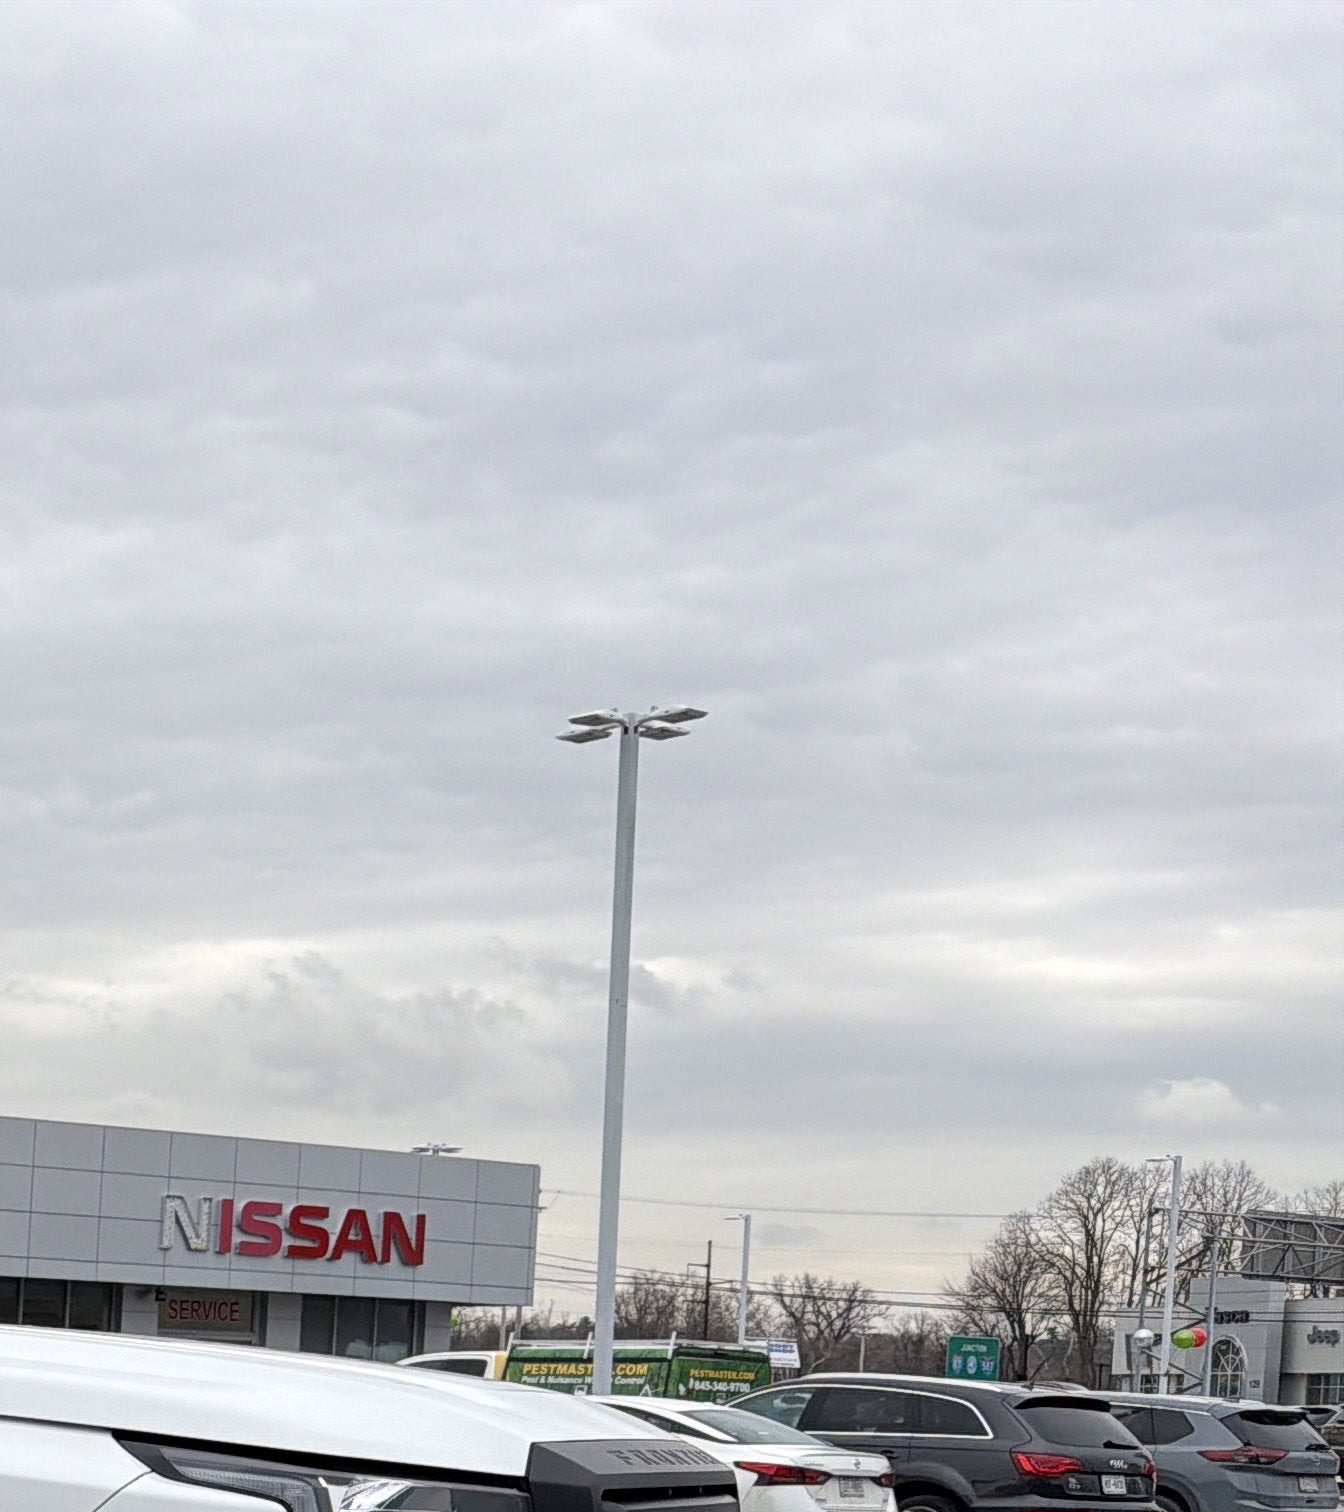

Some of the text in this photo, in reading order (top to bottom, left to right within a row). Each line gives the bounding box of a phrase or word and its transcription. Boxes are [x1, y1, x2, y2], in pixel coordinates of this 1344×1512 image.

[160, 1196, 426, 1266] NISSAN
[168, 1299, 240, 1322] SERVICE
[1307, 1325, 1340, 1347] Jeep
[523, 1363, 648, 1375] PESTMAST.COM
[615, 1376, 646, 1385] Control
